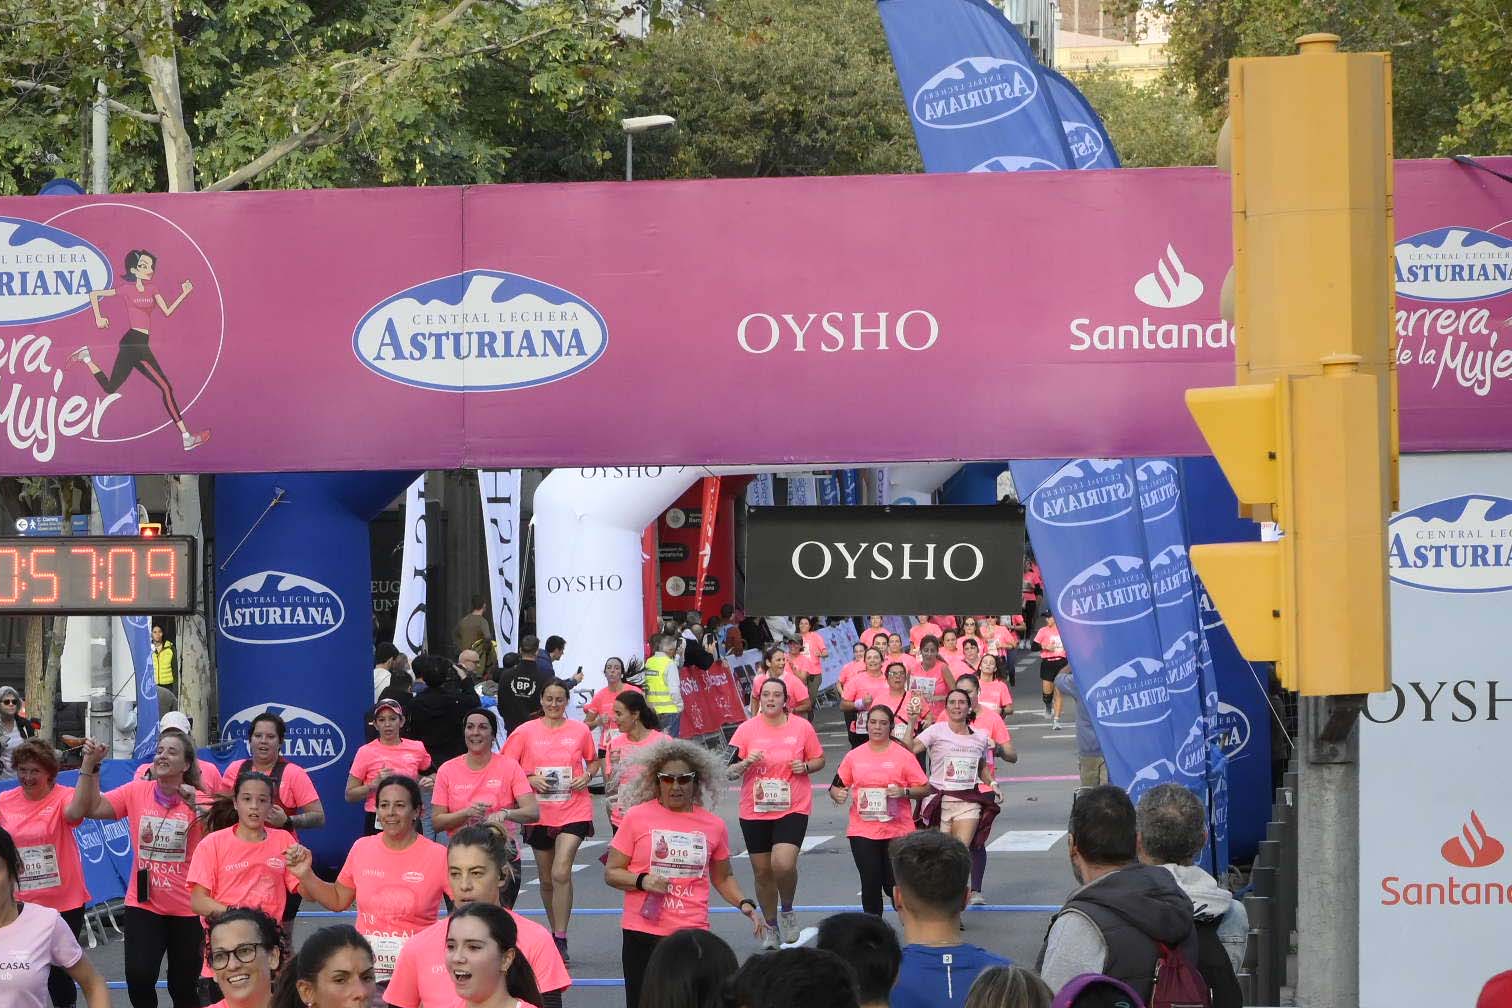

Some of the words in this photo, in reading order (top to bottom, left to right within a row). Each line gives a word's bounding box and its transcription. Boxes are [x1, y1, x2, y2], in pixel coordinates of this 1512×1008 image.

[15, 253, 87, 265] LECHERA
[412, 313, 490, 326] CENTRAL
[498, 311, 579, 323] LECHERA
[373, 317, 588, 361] ASTURIANA
[737, 310, 939, 353] OYSHO
[1419, 339, 1436, 365] la
[1416, 530, 1483, 538] CENTRAL
[792, 541, 984, 581] OYSHO
[548, 574, 623, 594] OYSHO
[235, 596, 278, 605] CENTRAL
[282, 595, 331, 604] LECHERA
[222, 600, 336, 627] ASTURIANA
[516, 681, 530, 690] BP
